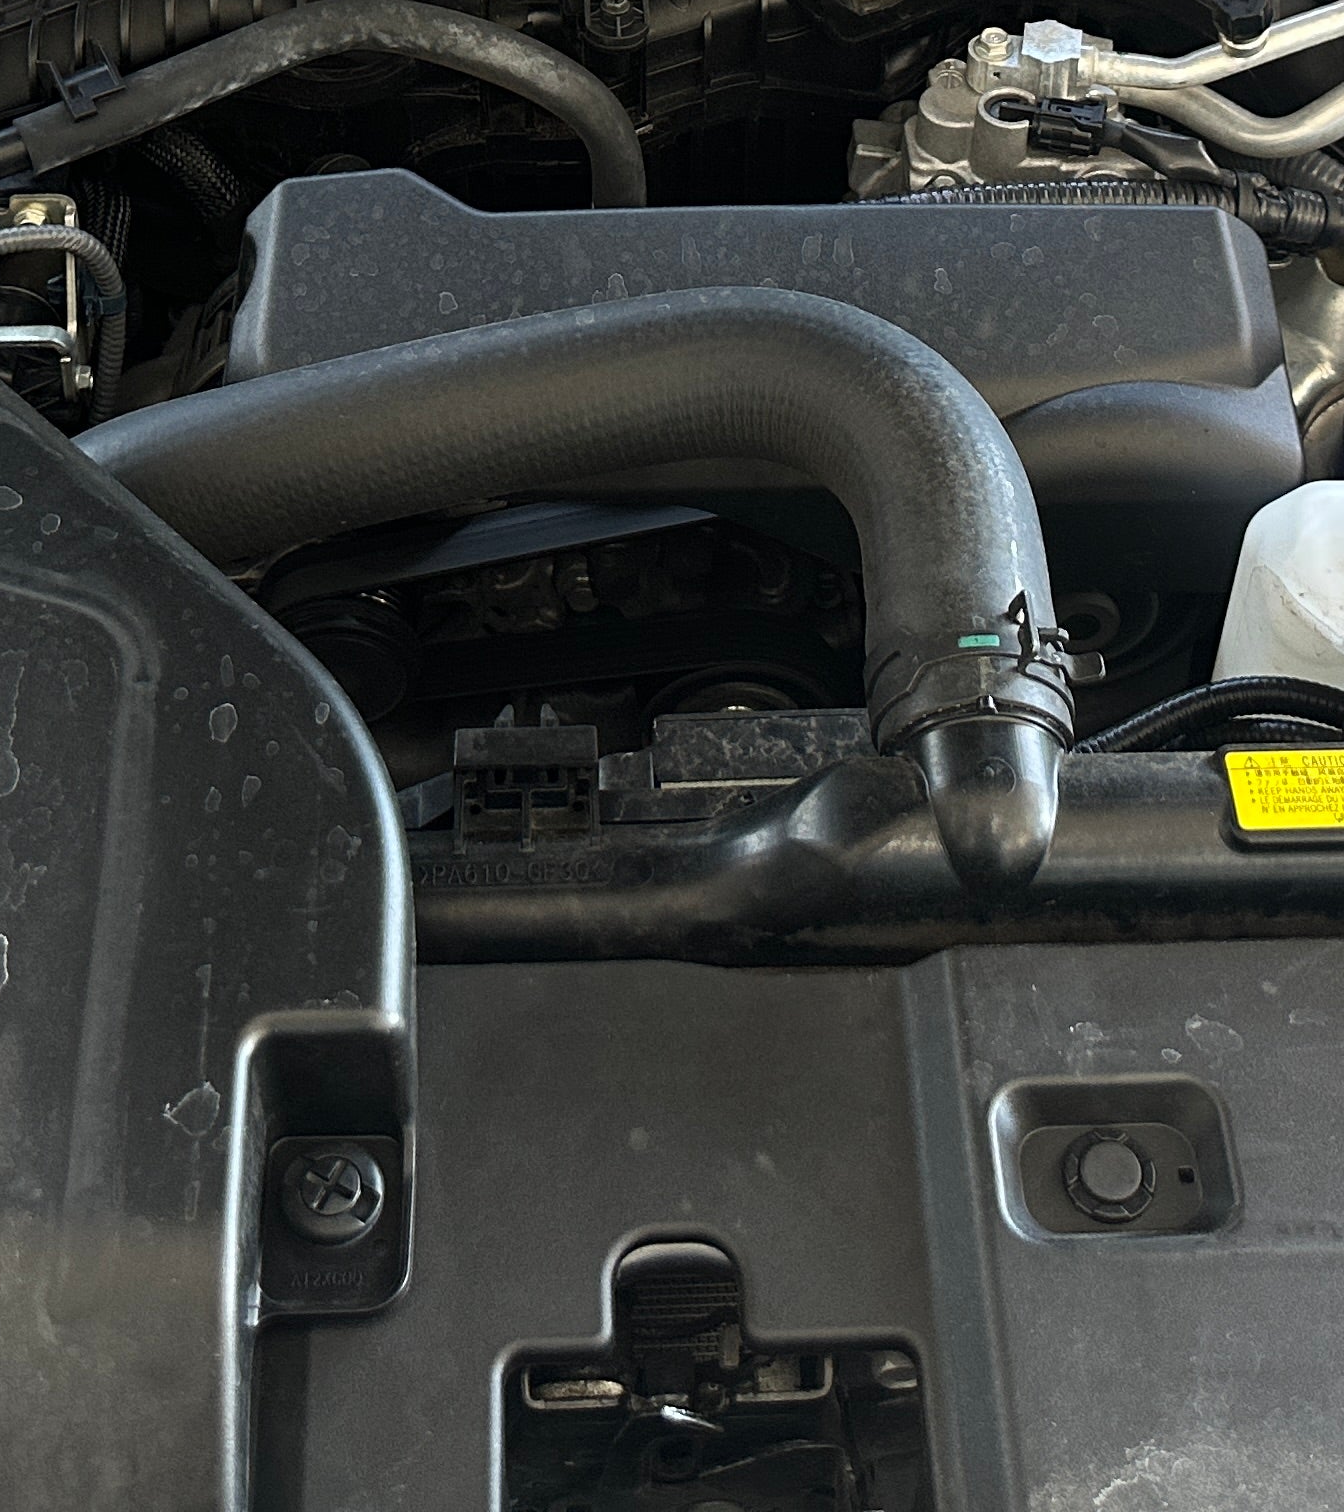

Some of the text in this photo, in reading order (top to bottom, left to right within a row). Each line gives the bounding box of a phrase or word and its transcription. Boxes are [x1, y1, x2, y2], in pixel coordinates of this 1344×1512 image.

[1258, 786, 1282, 795] KEEP
[1285, 785, 1318, 795] HANDS
[1326, 794, 1338, 803] DU
